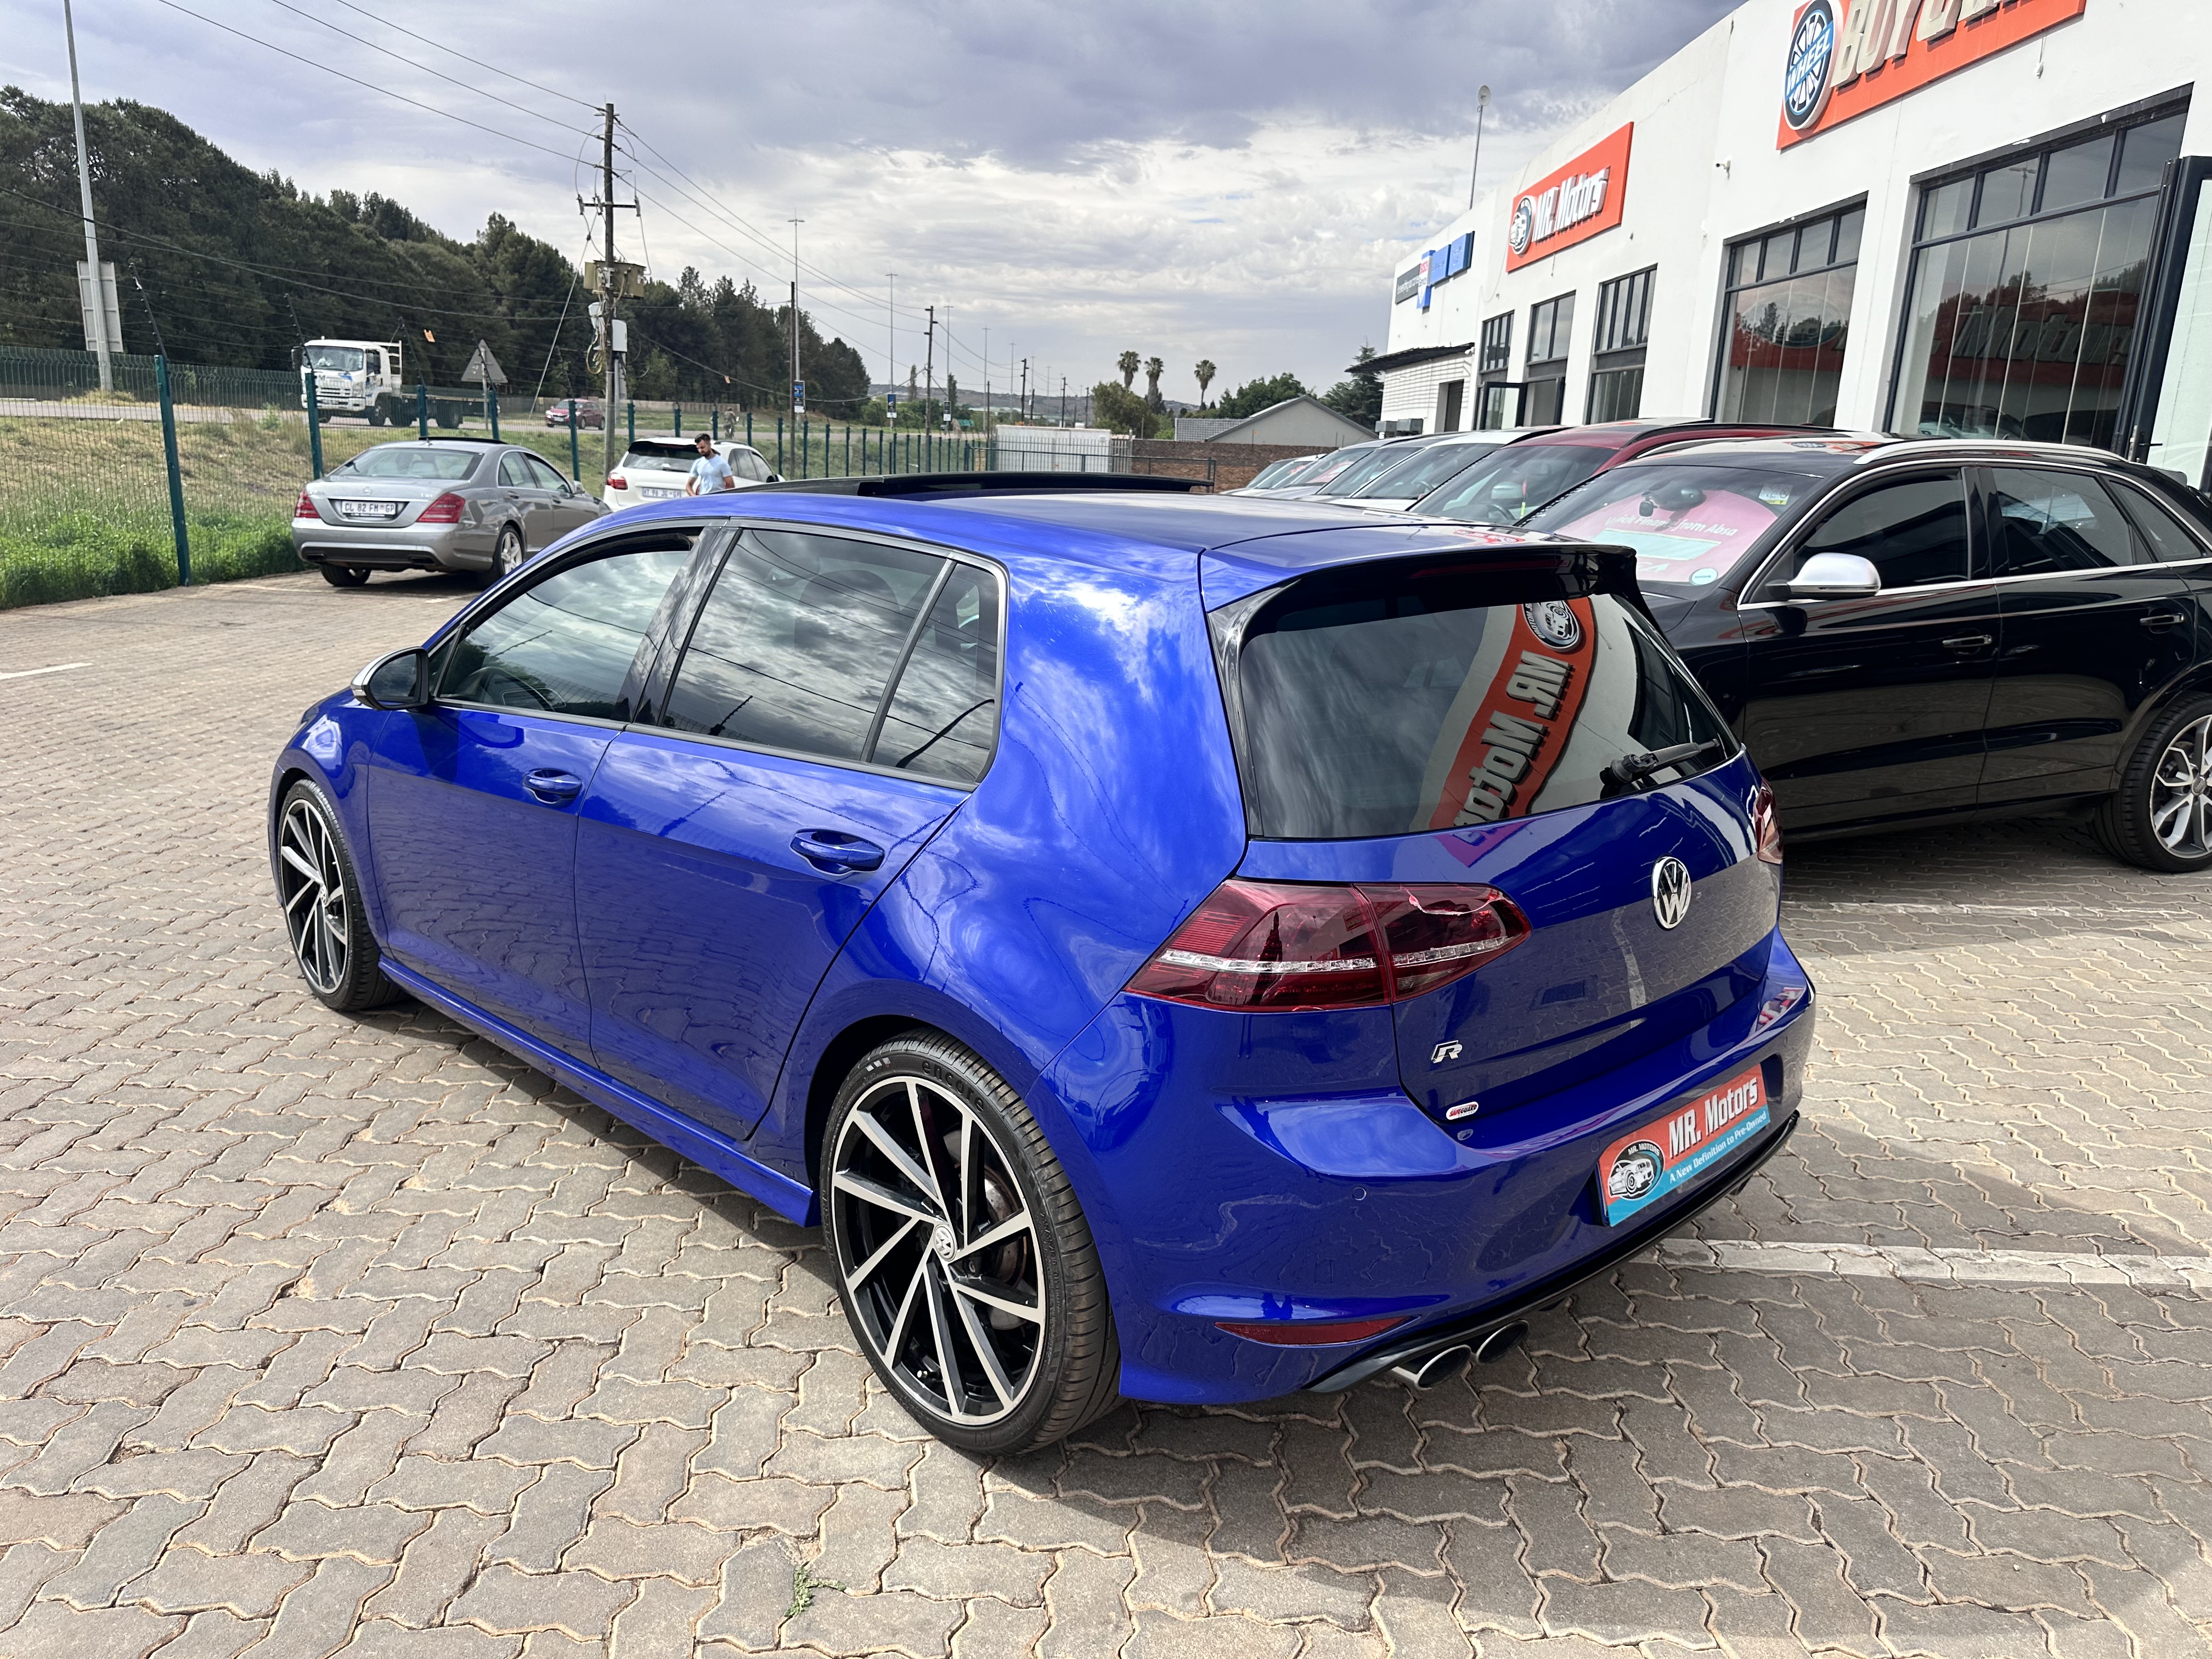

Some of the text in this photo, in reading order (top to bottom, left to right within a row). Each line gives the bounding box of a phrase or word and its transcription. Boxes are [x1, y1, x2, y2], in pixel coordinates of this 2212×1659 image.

[1786, 27, 1831, 97] WHEEL
[1553, 166, 1609, 231] Motors
[345, 503, 354, 512] CL
[357, 503, 367, 512] 82
[385, 504, 395, 513] GP
[1671, 518, 1707, 532] from
[1705, 523, 1739, 537] Absa
[1431, 1041, 1463, 1064] R
[1668, 1077, 1758, 1159] MR. Motors
[1638, 1143, 1661, 1156] MOTORS
[1669, 1110, 1767, 1183] A New Definition to Pre-Owned
